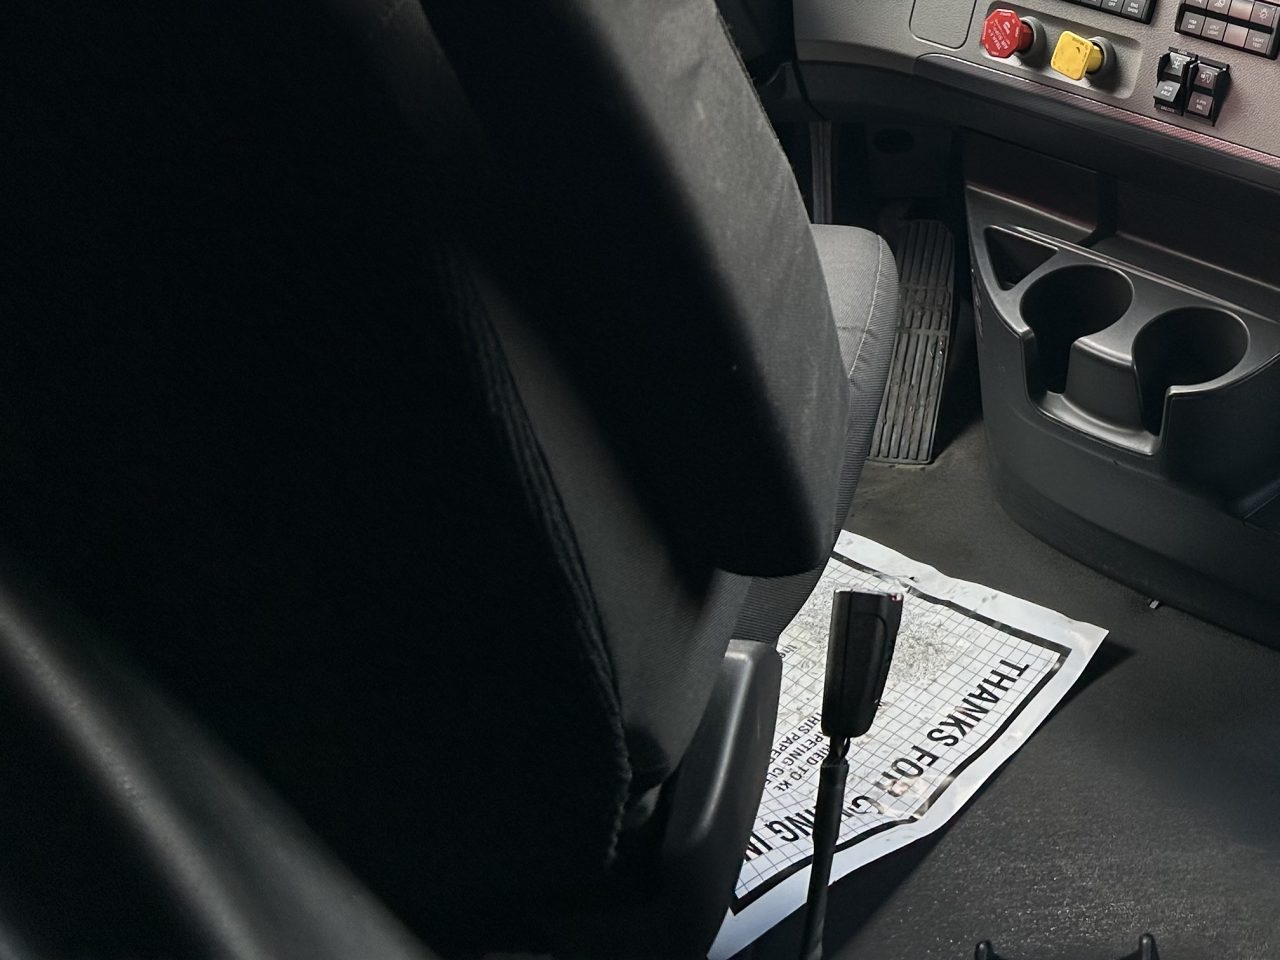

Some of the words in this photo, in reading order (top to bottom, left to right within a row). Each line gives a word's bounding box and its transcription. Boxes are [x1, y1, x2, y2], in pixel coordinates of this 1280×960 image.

[927, 659, 1030, 747] THANKS
[798, 711, 822, 736] THIS
[790, 767, 809, 782] TO
[873, 745, 940, 798] FOR
